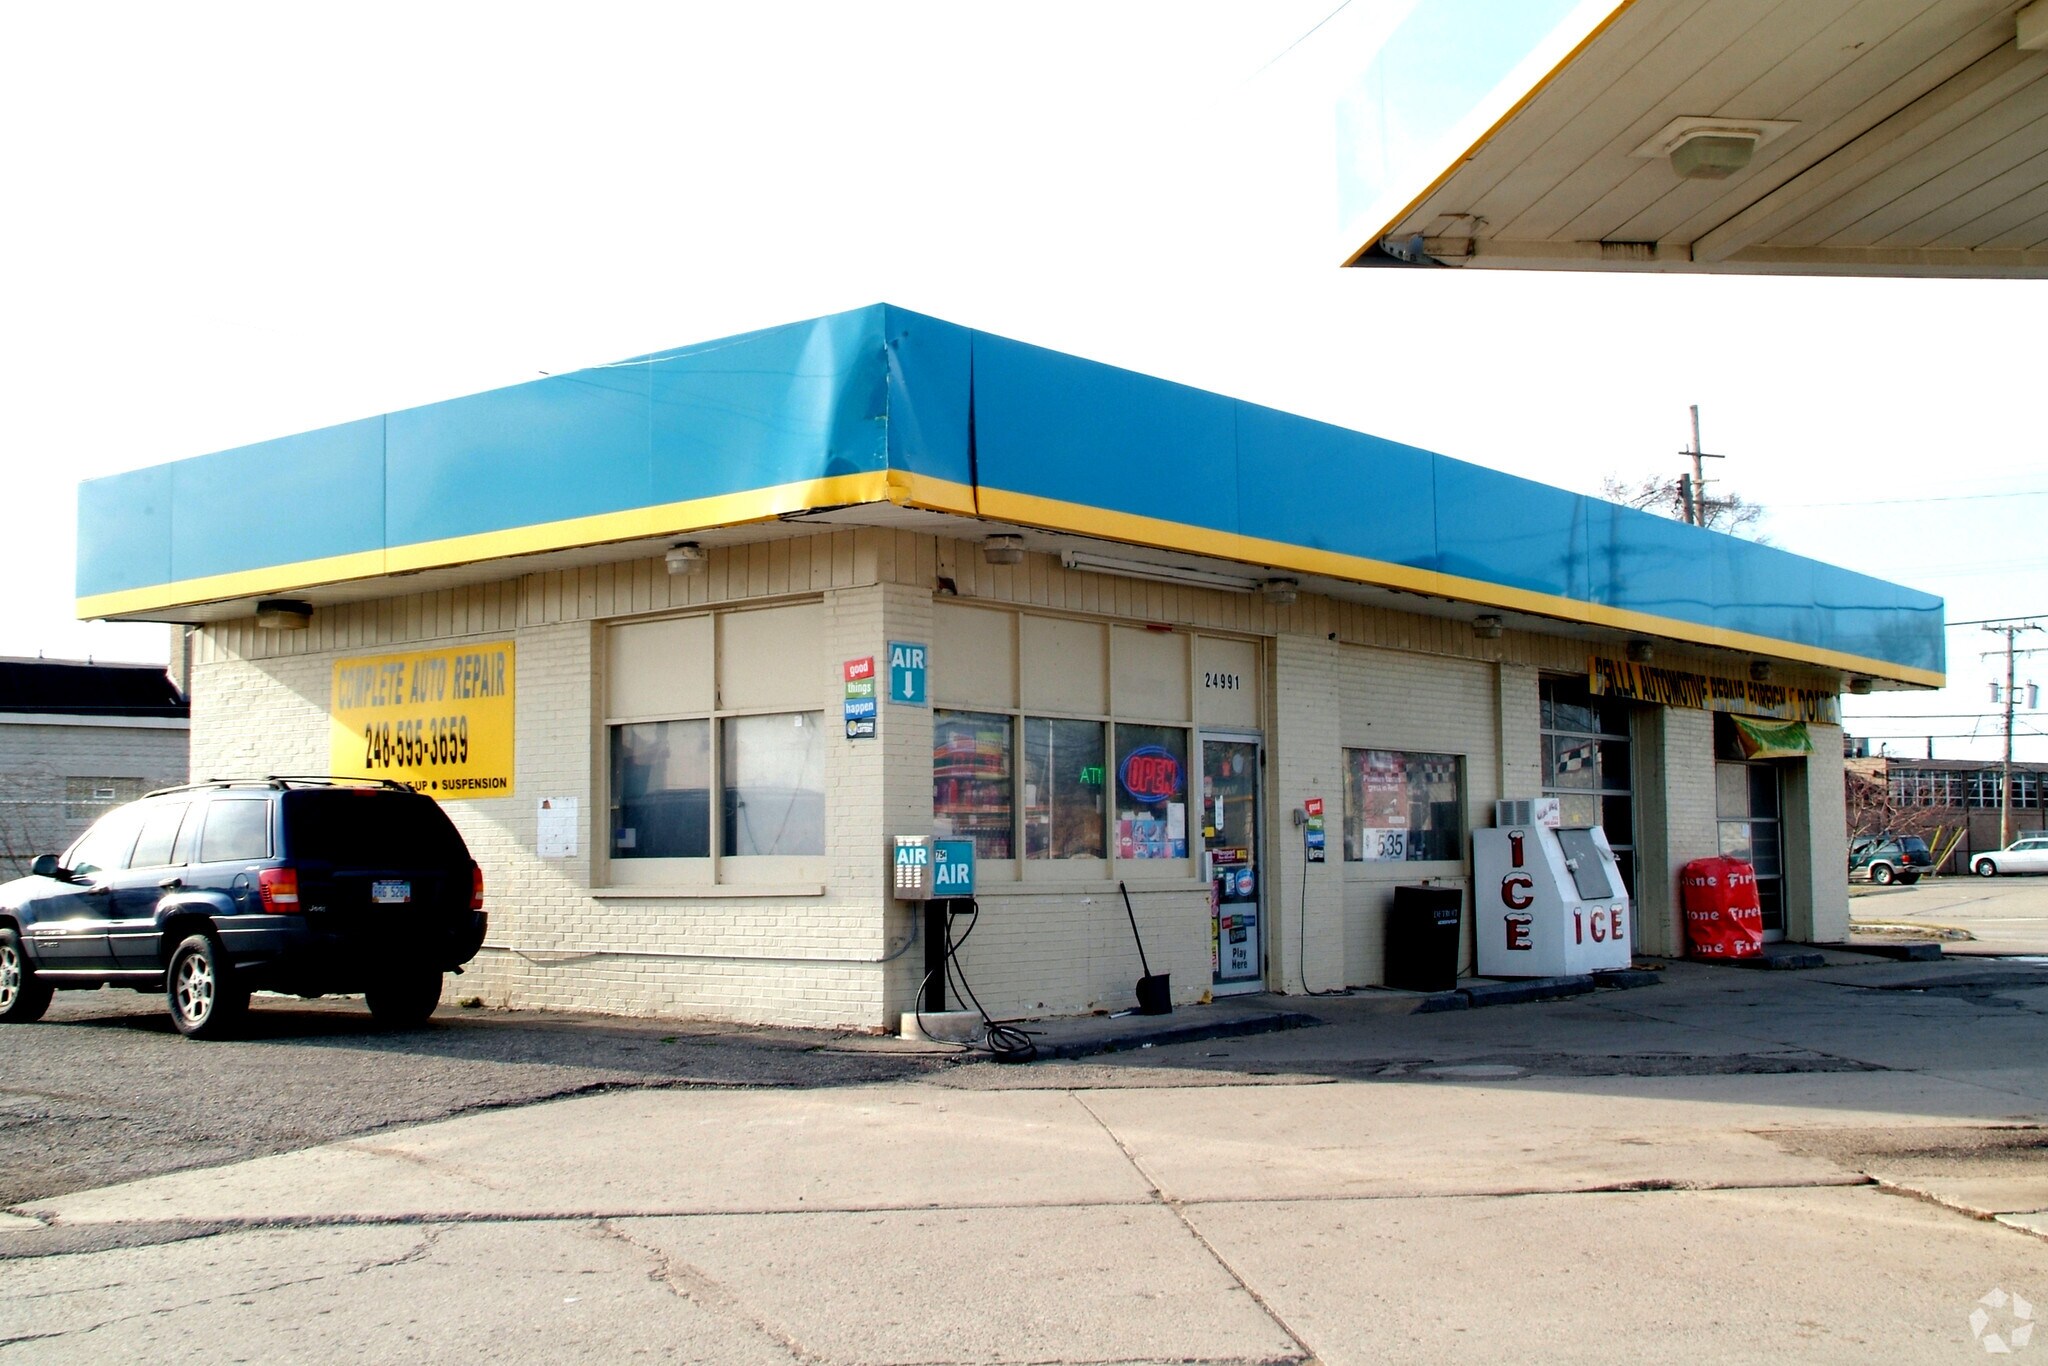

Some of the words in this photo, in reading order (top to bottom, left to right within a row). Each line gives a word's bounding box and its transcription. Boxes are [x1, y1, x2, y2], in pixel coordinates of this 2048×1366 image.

[892, 648, 924, 669] AIR
[849, 660, 869, 677] good
[338, 663, 404, 710] COMPLETE
[410, 657, 447, 703] AUTO
[453, 651, 505, 699] REPAIR
[847, 682, 872, 695] things
[1205, 672, 1240, 690] 24991
[1639, 665, 1708, 709] AUTOMOTIVE
[845, 702, 874, 715] happen
[365, 715, 468, 769] 248-595-3659
[441, 777, 507, 790] SUSPENSION
[1127, 756, 1177, 796] OPEN
[897, 848, 927, 864] AIR
[936, 864, 969, 884] AIR
[1501, 829, 1534, 951] ICE
[1573, 902, 1624, 945] ICE
[1232, 947, 1247, 960] Play
[1232, 959, 1248, 970] Here
